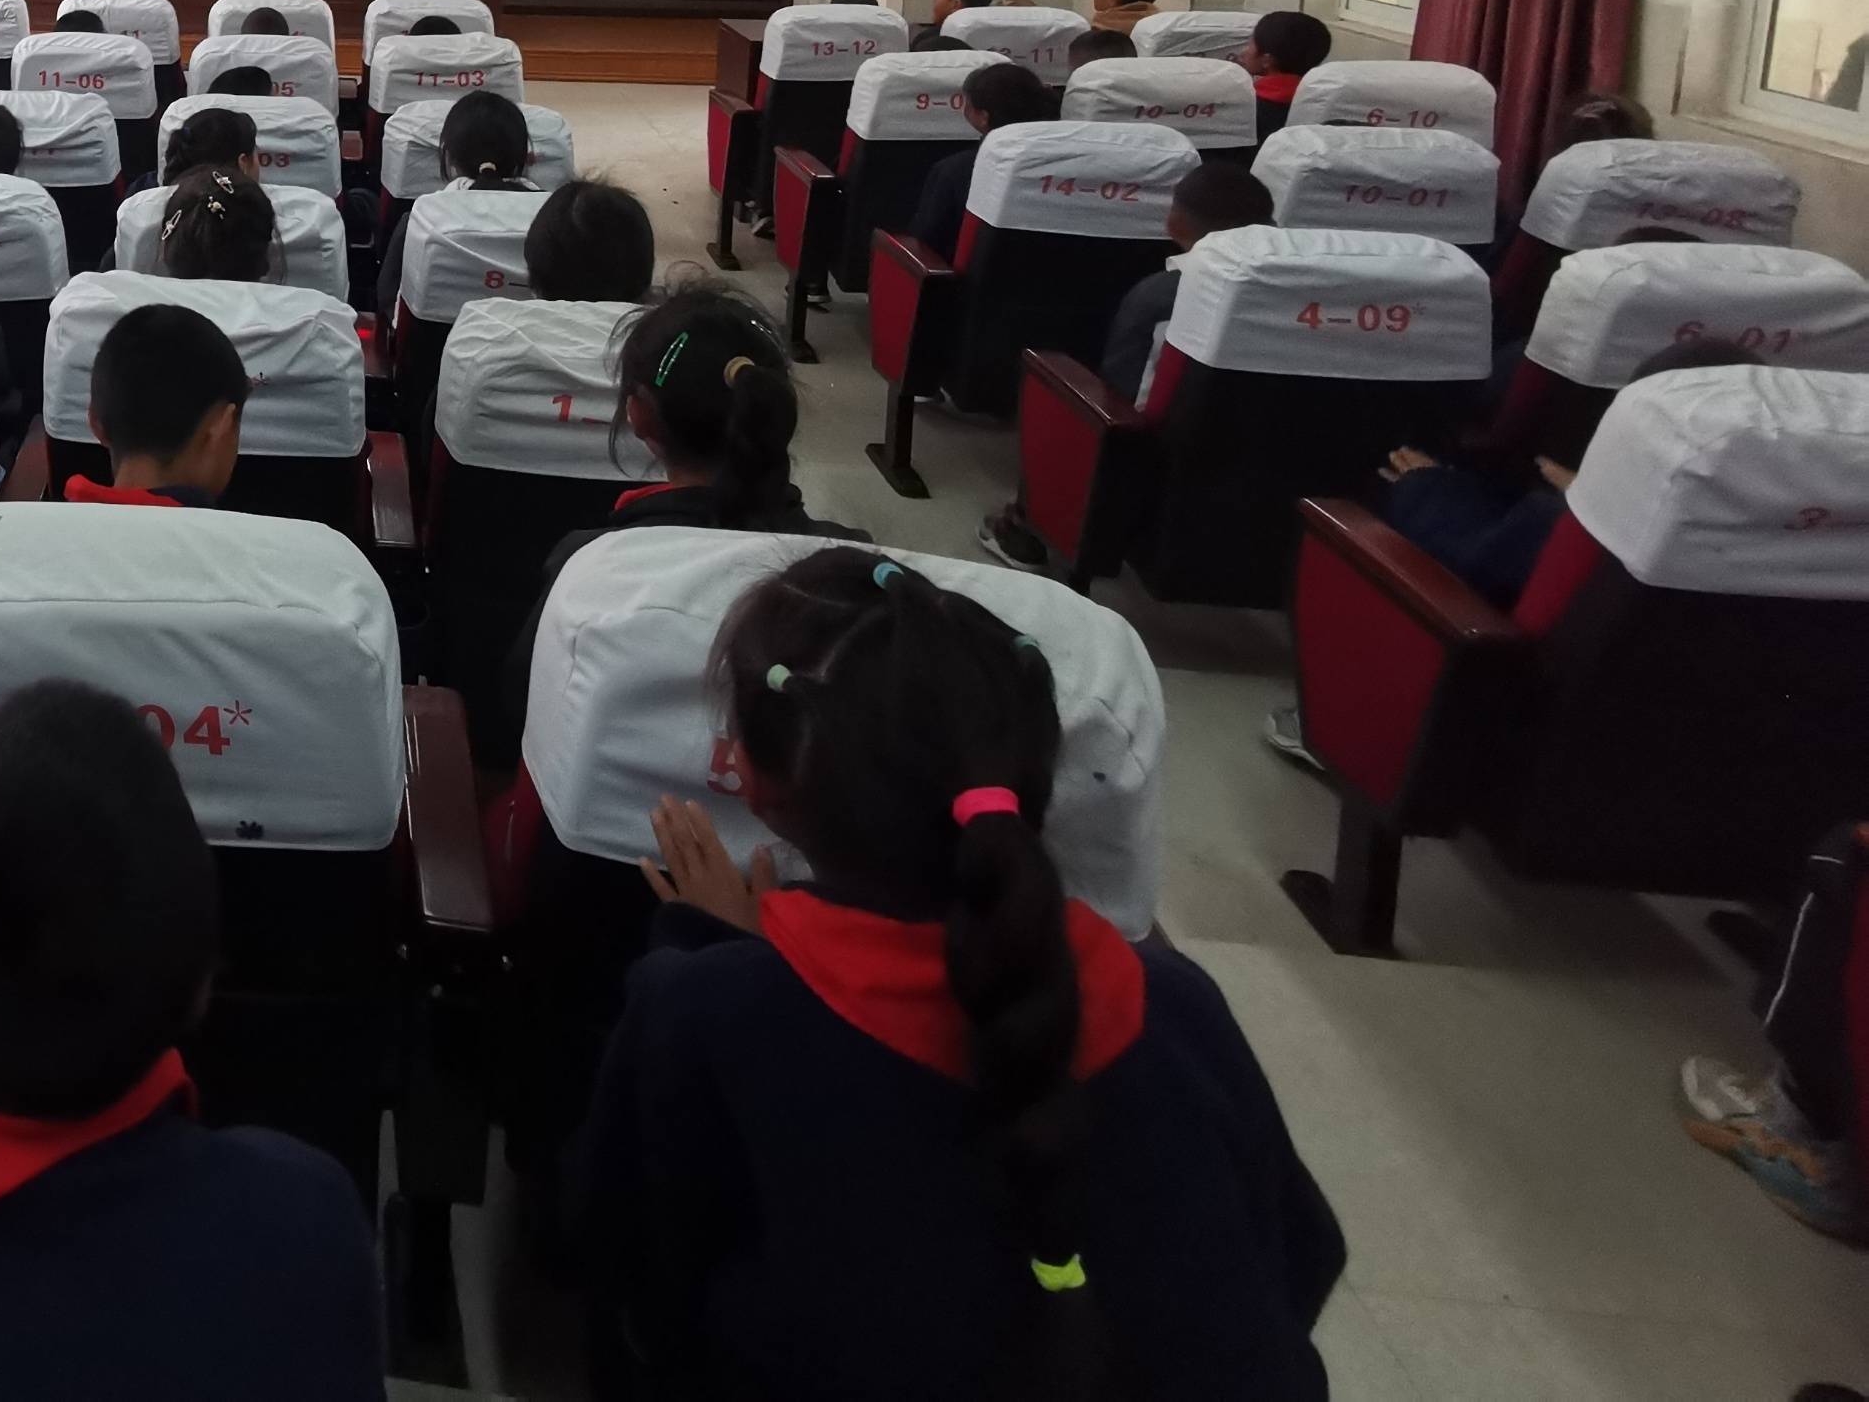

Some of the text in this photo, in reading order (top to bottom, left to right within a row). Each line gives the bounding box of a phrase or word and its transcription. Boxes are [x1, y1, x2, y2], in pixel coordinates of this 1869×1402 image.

[811, 40, 876, 56] 13-12
[38, 70, 104, 90] 11-06
[415, 70, 485, 88] 11-03
[916, 93, 963, 110] 9-0
[1136, 103, 1216, 119] 10-04
[1366, 108, 1441, 128] 6-10
[258, 153, 290, 168] 03
[1039, 174, 1140, 202] 14-02
[1343, 184, 1449, 208] 10-01
[484, 270, 529, 289] 8-
[1296, 302, 1411, 333] 4-09
[551, 394, 606, 424] 1-
[136, 705, 232, 756] 04
